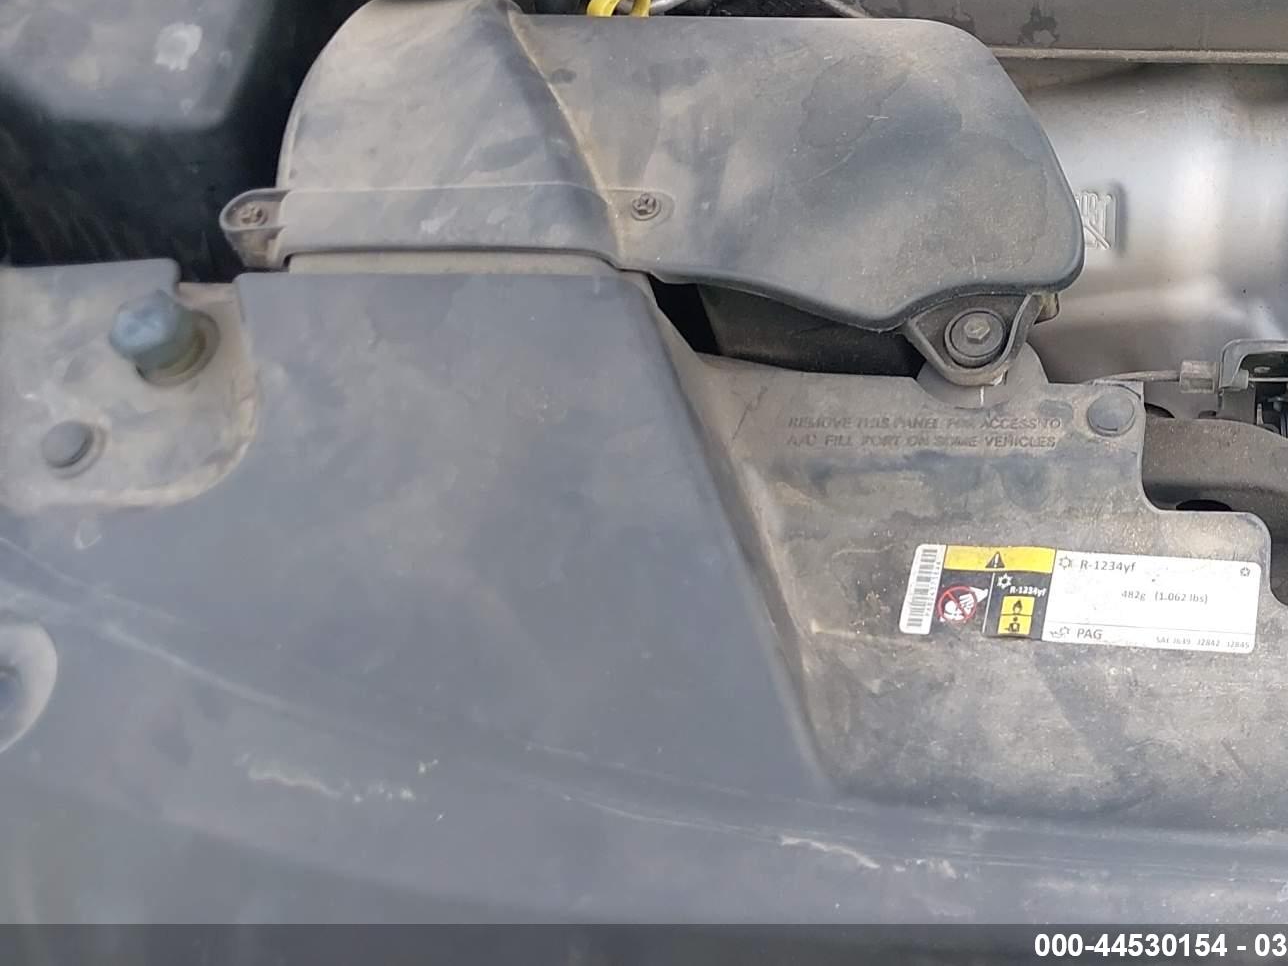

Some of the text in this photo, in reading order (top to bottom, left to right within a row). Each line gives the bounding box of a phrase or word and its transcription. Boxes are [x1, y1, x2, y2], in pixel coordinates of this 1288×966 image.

[788, 417, 849, 429] REMOVE
[894, 417, 939, 429] PANEL
[980, 417, 1038, 430] ACCESS
[1040, 417, 1061, 430] TO
[824, 435, 851, 447] FILL
[860, 435, 900, 447] PORT
[906, 435, 929, 447] ON
[985, 435, 1056, 448] VEHICLES
[1079, 559, 1137, 573] R-1234yf
[1121, 590, 1146, 601] 482g
[1076, 629, 1103, 640] PAG
